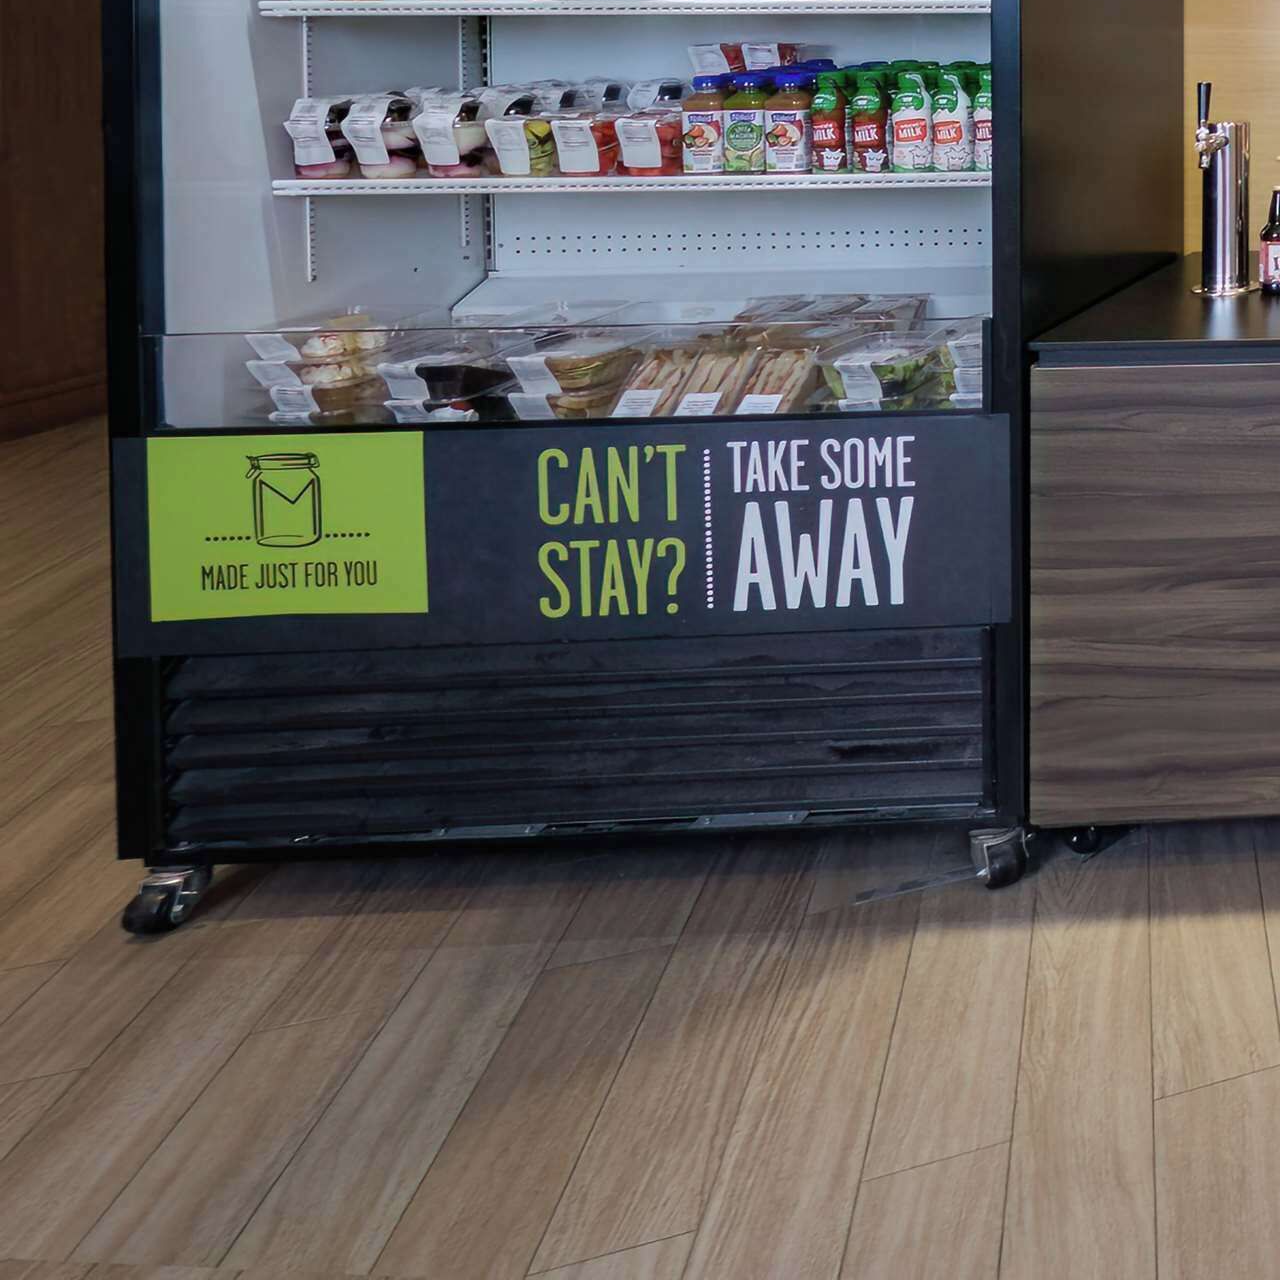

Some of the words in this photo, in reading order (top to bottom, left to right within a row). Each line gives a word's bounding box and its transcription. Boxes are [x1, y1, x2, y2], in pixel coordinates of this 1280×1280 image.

[898, 126, 922, 138] MILK
[936, 127, 957, 140] MILK
[537, 443, 687, 527] CAN'T
[727, 438, 810, 494] TAKE
[819, 434, 916, 490] SOME
[201, 564, 250, 592] MADE
[254, 563, 300, 590] JUST
[304, 562, 340, 589] FOR
[342, 560, 379, 587] YOU
[538, 535, 687, 620] STAY?
[733, 496, 916, 613] AWAY
